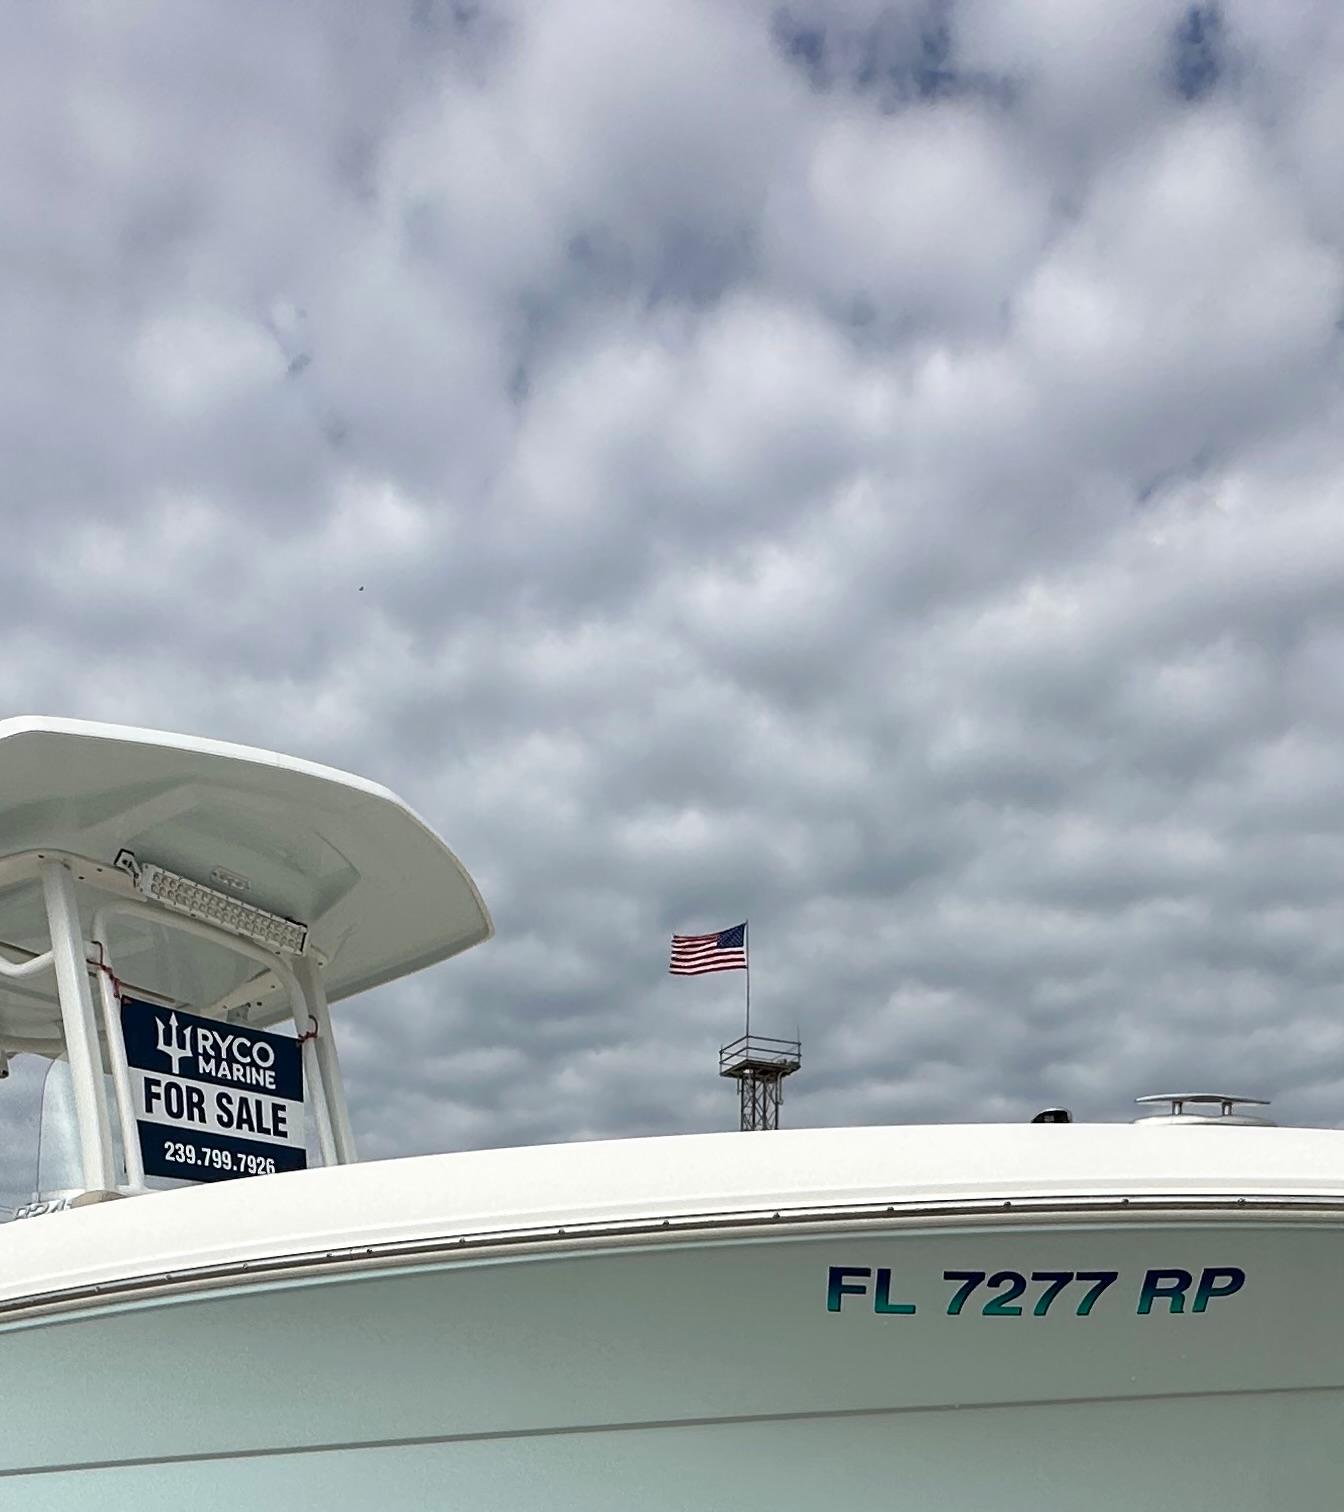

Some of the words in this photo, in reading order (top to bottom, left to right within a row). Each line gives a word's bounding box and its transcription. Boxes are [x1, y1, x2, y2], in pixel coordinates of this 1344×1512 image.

[198, 1029, 274, 1067] RYCO
[199, 1056, 276, 1090] MARINE
[145, 1078, 207, 1124] FOR
[216, 1093, 288, 1138] SALE
[165, 1142, 275, 1175] 239.799.7926
[827, 1267, 916, 1315] FL
[943, 1271, 1118, 1316] 7277
[1137, 1267, 1245, 1314] RP
